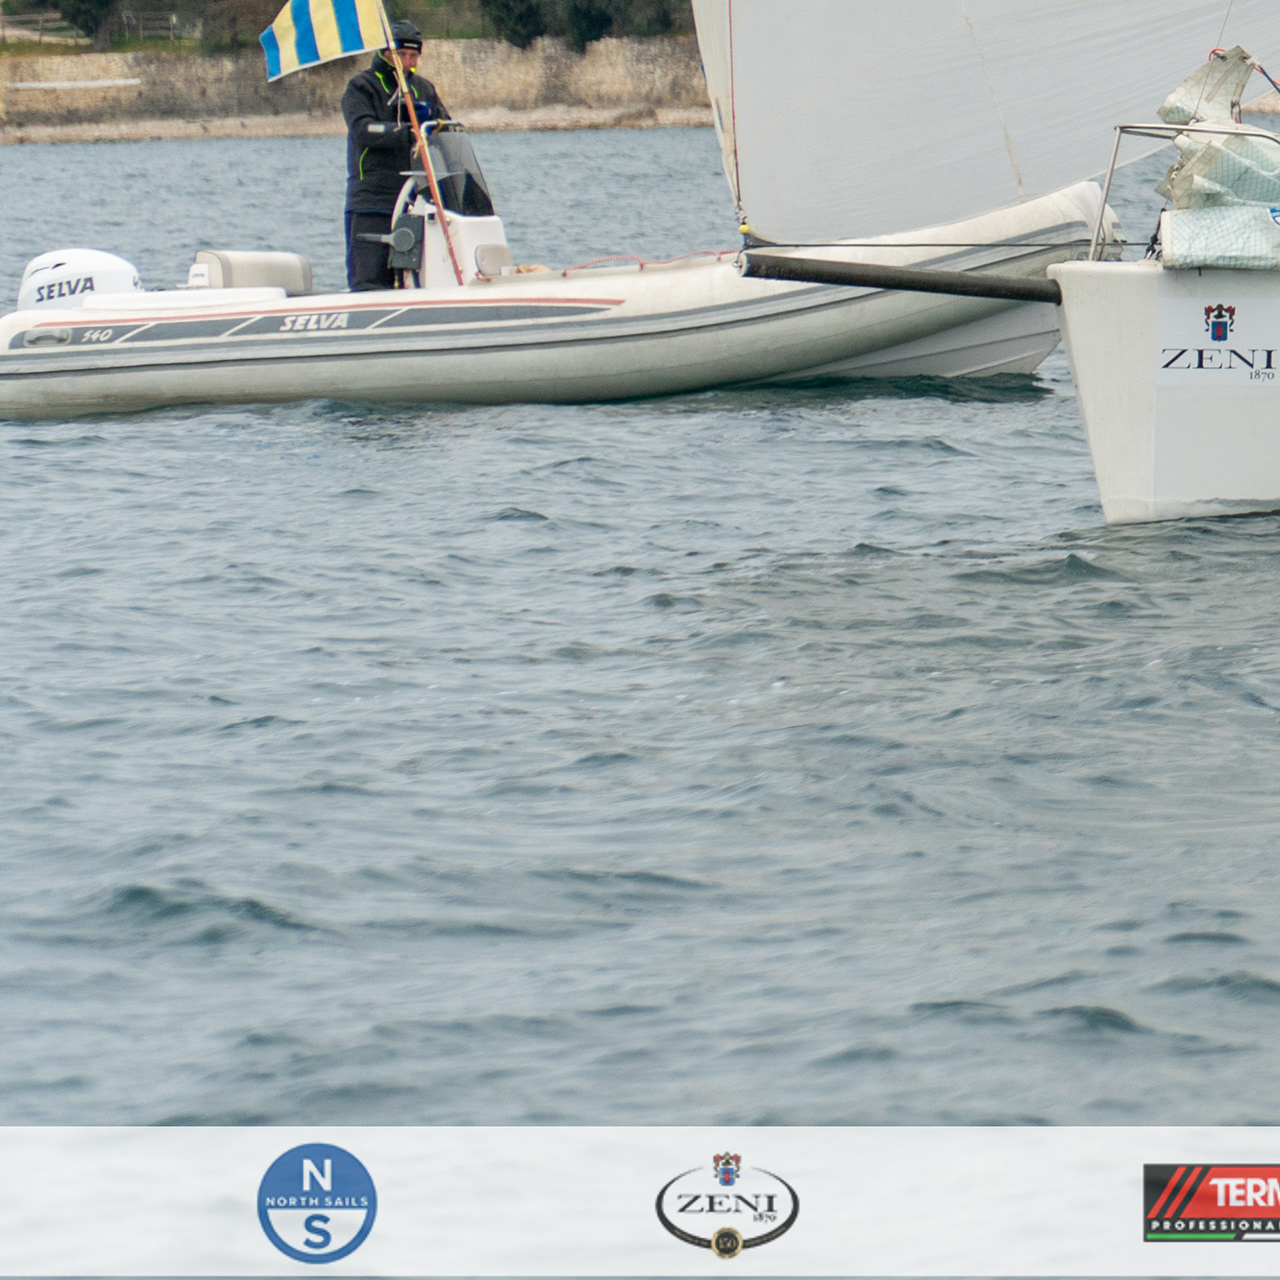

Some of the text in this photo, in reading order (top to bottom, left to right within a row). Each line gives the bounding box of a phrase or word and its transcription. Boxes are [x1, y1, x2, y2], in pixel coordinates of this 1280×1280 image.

[35, 276, 95, 303] SELVA
[279, 313, 349, 331] SELVA
[1161, 348, 1277, 370] ZENI
[1249, 370, 1275, 381] 1870
